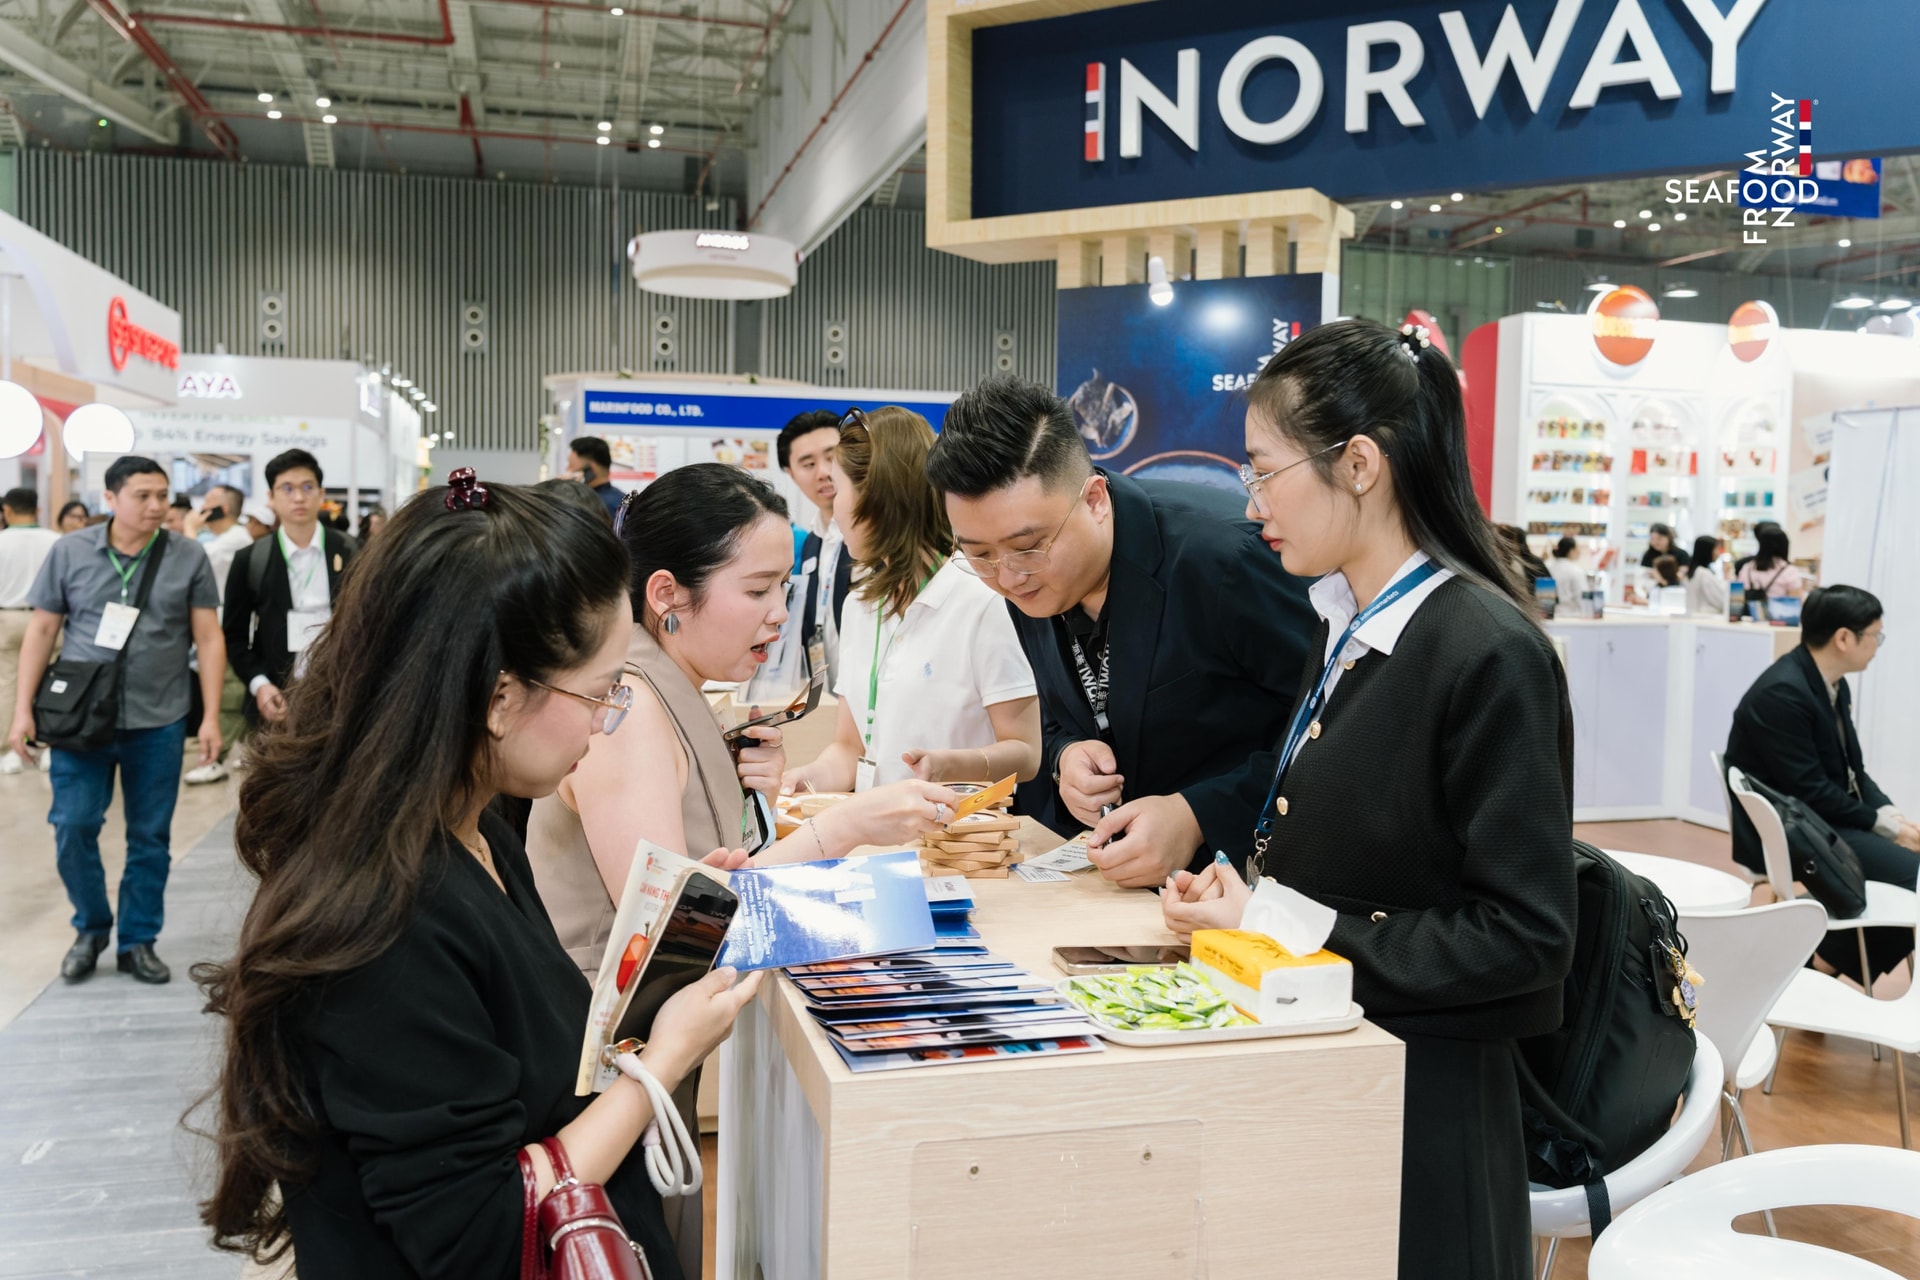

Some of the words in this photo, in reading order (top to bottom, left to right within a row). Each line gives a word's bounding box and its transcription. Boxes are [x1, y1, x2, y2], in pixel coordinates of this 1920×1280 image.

[1120, 0, 1770, 158] NORWAY
[1272, 318, 1289, 354] WAY
[1212, 373, 1257, 392] SEAF
[194, 431, 256, 448] Energy
[261, 434, 328, 448] Savings
